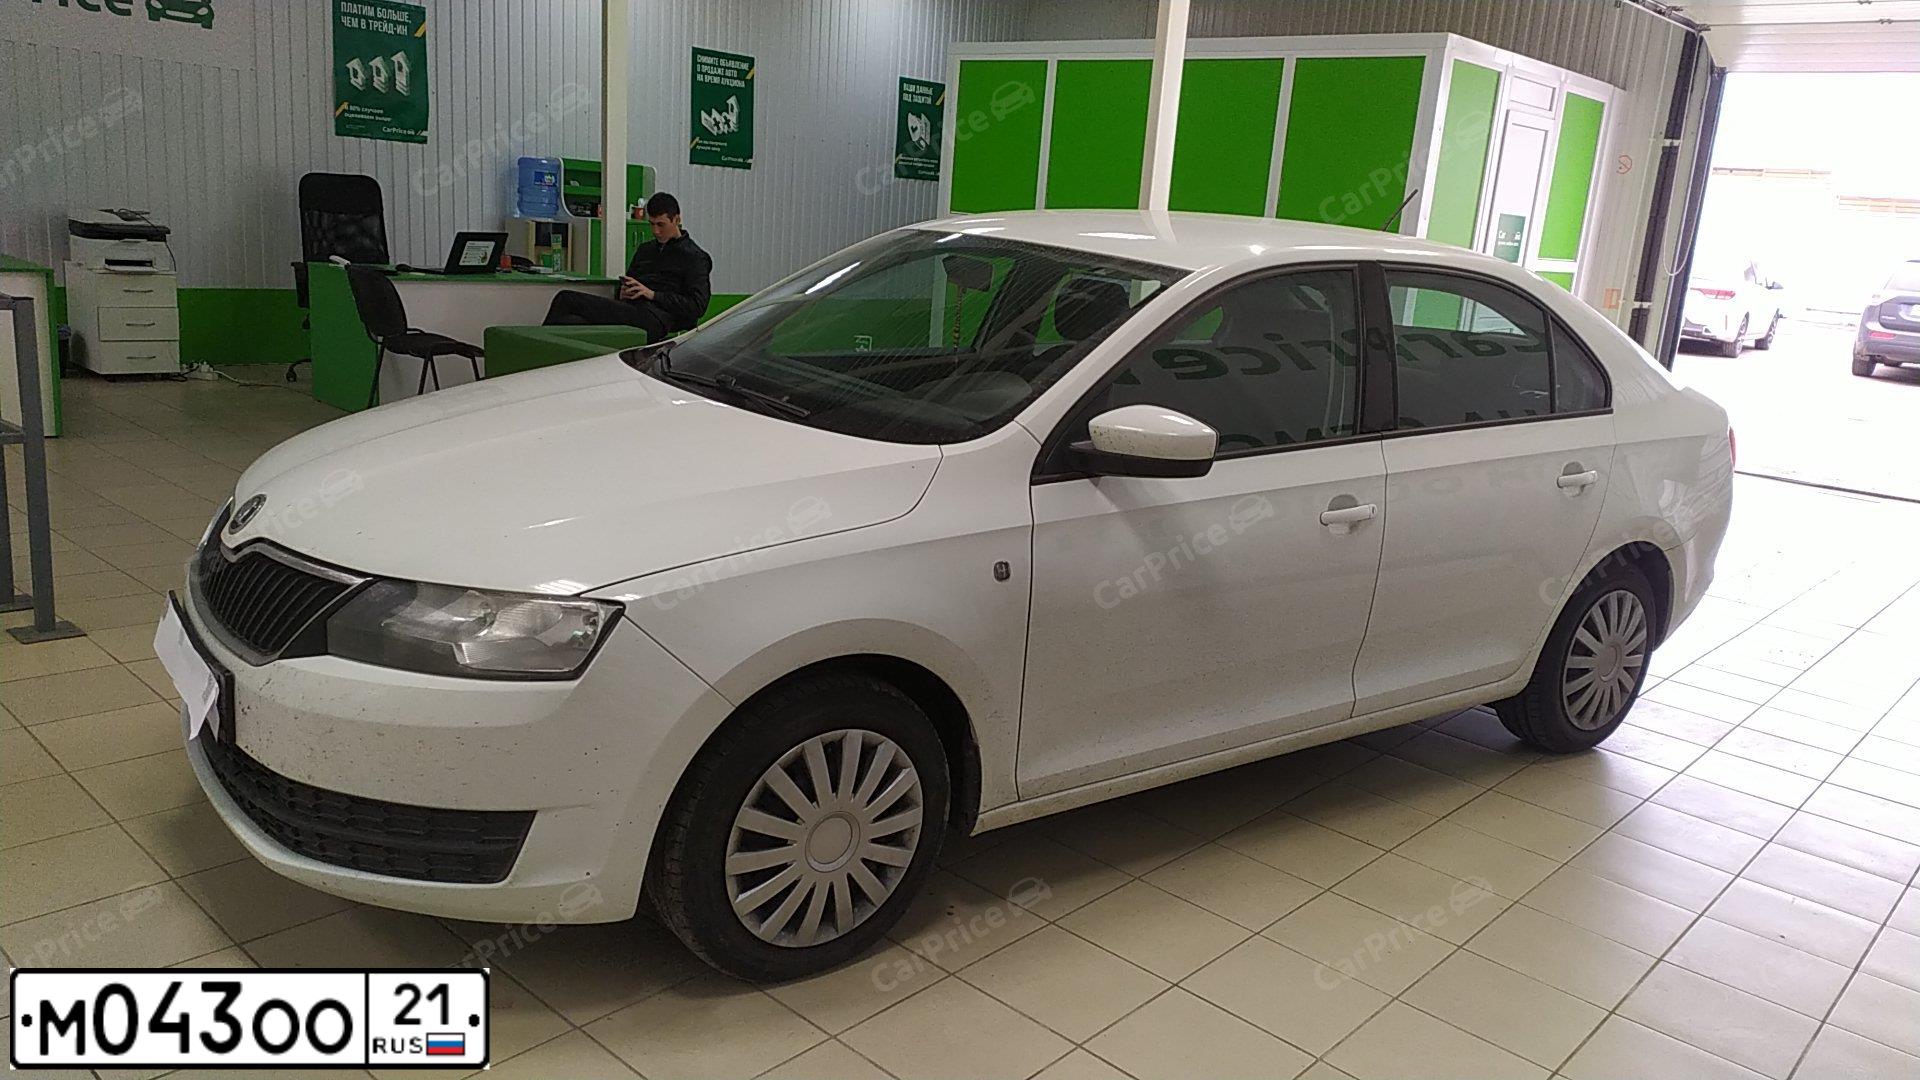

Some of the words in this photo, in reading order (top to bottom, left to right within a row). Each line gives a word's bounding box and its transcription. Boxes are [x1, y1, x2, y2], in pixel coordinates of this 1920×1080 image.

[341, 2, 375, 17] ПЛАТИМ
[377, 7, 411, 24] БОЛЬШЕ,
[341, 16, 358, 28] ЧЕМ
[361, 19, 367, 29] В
[368, 20, 408, 36] ТРЕЙД-ИН
[697, 54, 720, 66] СНИМИТЕ
[697, 73, 704, 82] НА
[382, 126, 407, 135] CarPrice
